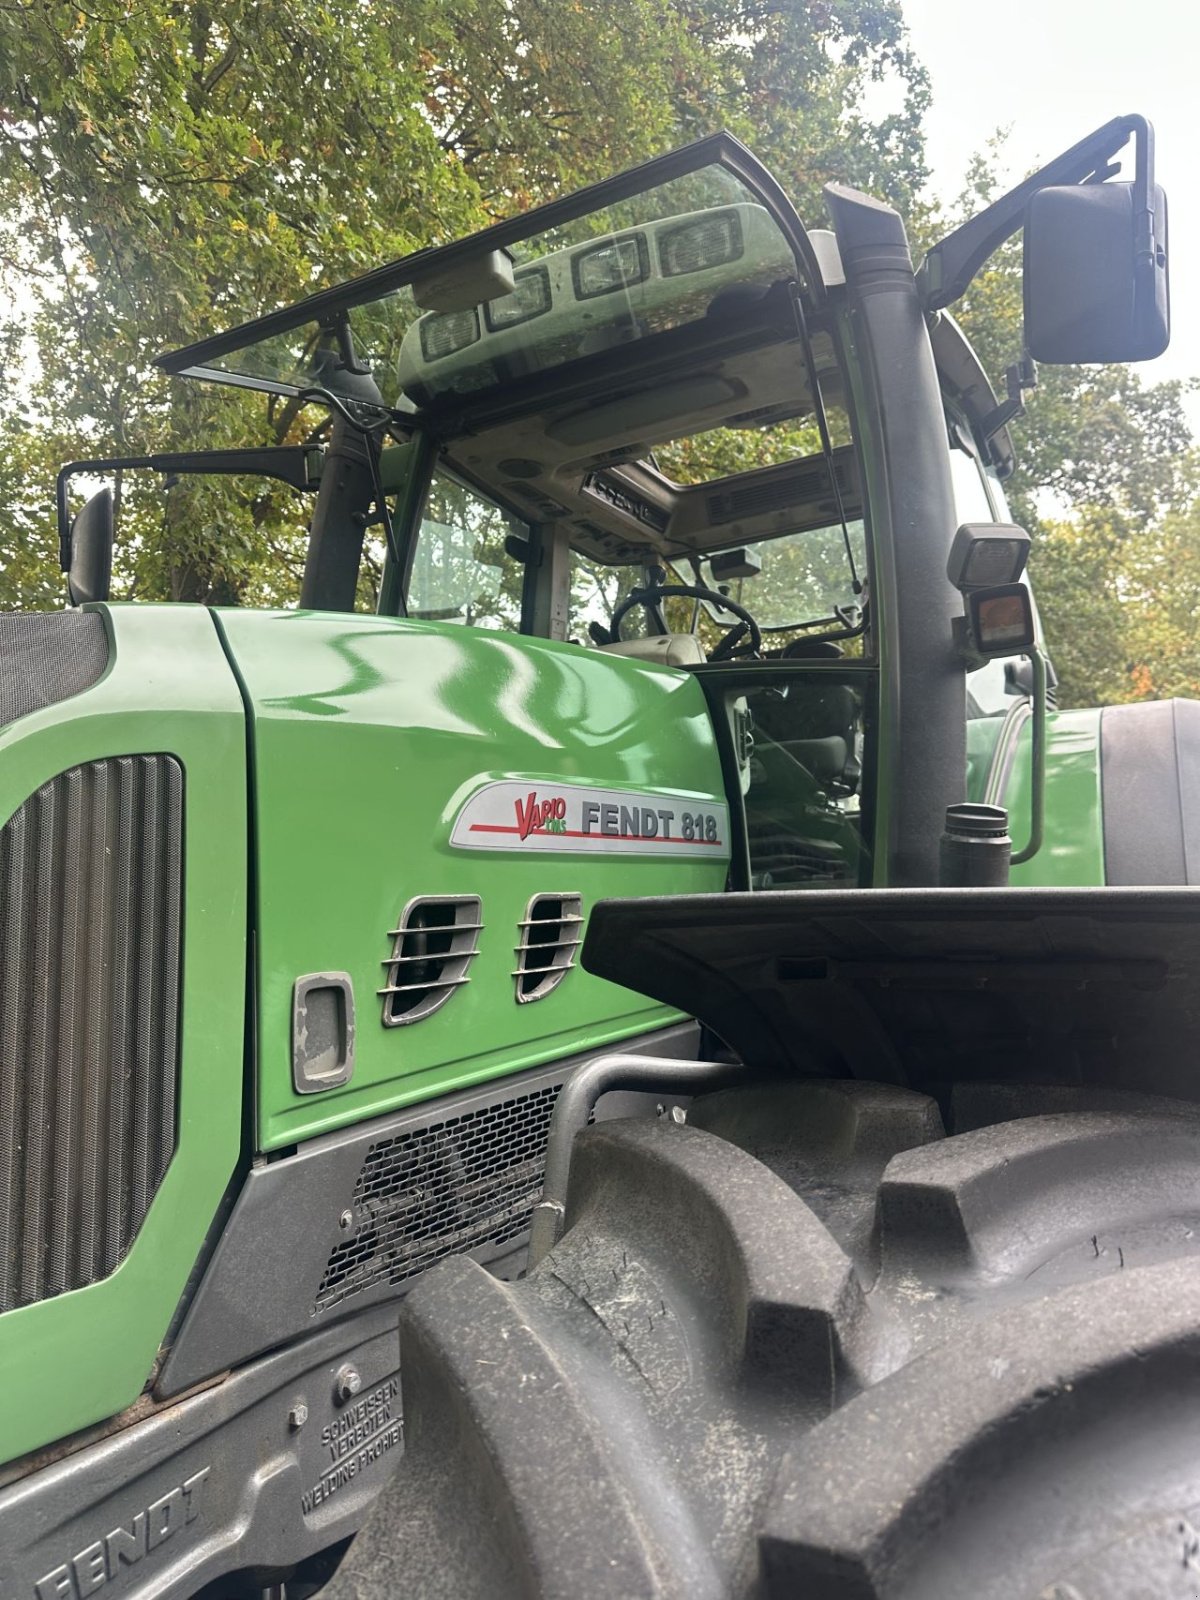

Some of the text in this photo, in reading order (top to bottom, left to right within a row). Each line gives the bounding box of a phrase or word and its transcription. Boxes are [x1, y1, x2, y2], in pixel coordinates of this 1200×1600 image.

[514, 792, 566, 841] VARIO
[545, 818, 566, 833] TMS
[582, 801, 717, 842] FENDT 818
[321, 1378, 398, 1446] SCHWEISSEN
[330, 1402, 391, 1462] VERBOTEN
[302, 1459, 355, 1515] WELDING
[35, 1466, 210, 1600] FENDT
